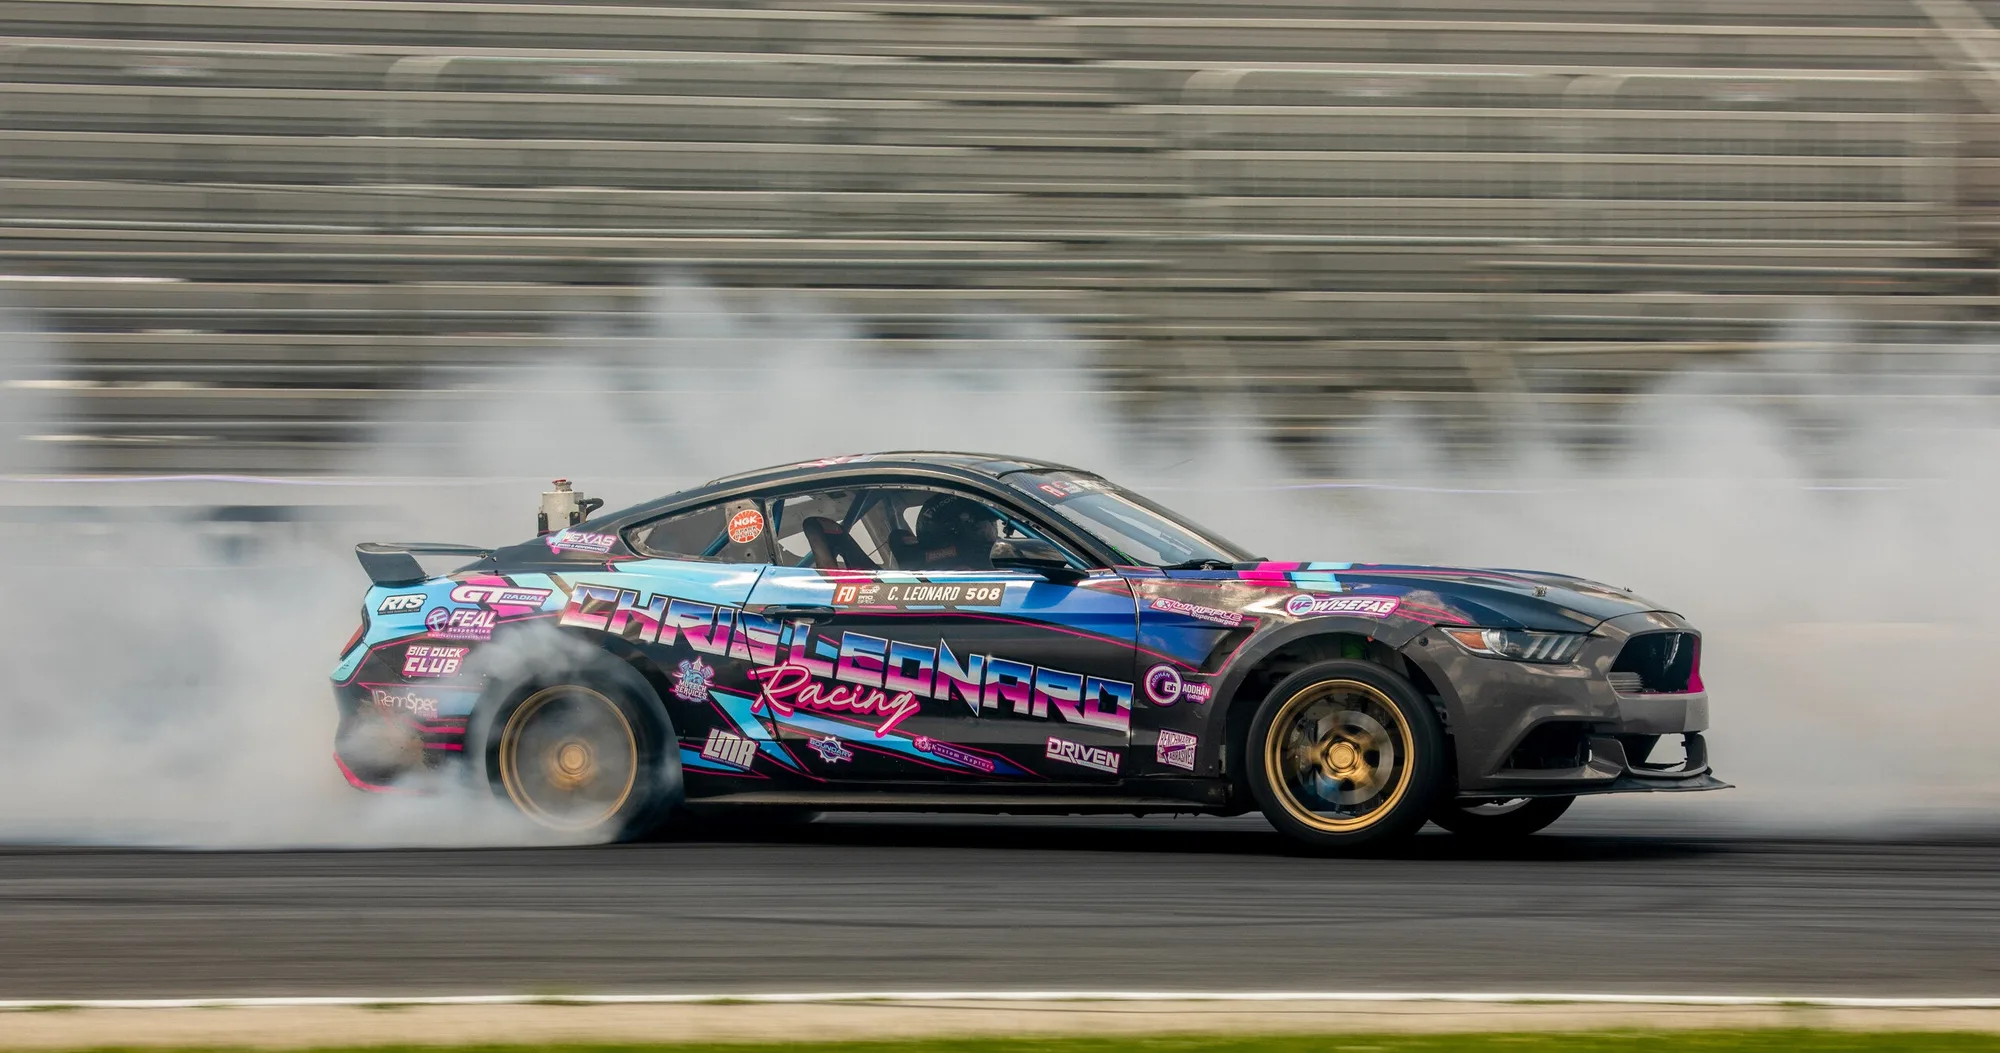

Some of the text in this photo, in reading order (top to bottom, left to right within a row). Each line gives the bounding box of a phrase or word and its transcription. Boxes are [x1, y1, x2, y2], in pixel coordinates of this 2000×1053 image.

[734, 515, 757, 528] NGK
[502, 593, 546, 602] RADIAL
[837, 586, 855, 602] FD
[887, 586, 899, 601] C.
[903, 586, 960, 601] LEONARD
[965, 587, 1001, 600] 508
[379, 594, 427, 611] RTS
[1314, 600, 1396, 614] WISEFAB
[448, 610, 497, 628] FEAL
[1173, 602, 1243, 622] WHIPPLE
[1190, 611, 1240, 627] Superchargers
[406, 646, 464, 657] BIG DUCK
[560, 582, 1134, 732] CHRIS LEONARD
[404, 658, 459, 674] CLUB
[674, 684, 708, 699] SERVICES
[749, 661, 919, 736] Racing
[1182, 683, 1210, 698] AODHÁN
[376, 689, 438, 715] RennSpec
[702, 728, 758, 767] LMR
[810, 738, 852, 758] BOUNDARY
[1049, 737, 1120, 768] DRIVEN
[931, 744, 995, 771] Kustom Kapture
